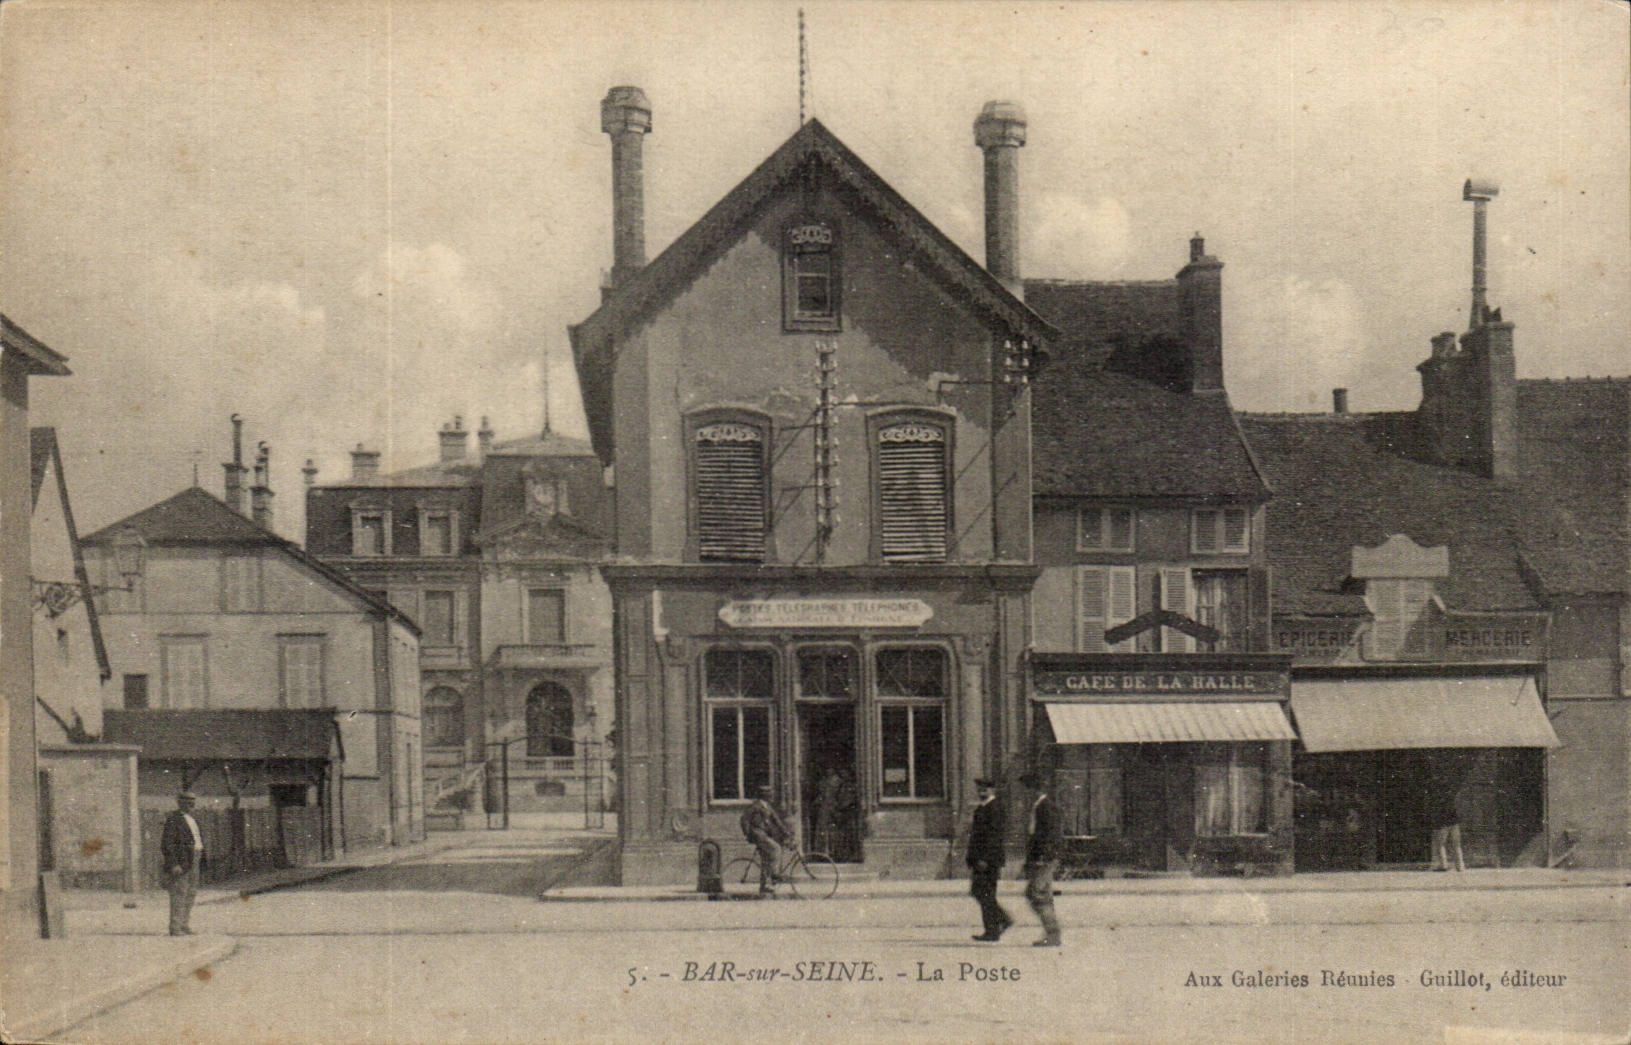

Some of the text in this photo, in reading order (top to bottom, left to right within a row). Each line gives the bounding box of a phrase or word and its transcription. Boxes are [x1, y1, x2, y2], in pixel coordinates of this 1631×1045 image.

[1445, 630, 1532, 647] MERCERIE
[1122, 676, 1146, 690] DE
[1157, 676, 1183, 690] LA
[1191, 675, 1255, 690] HALLE
